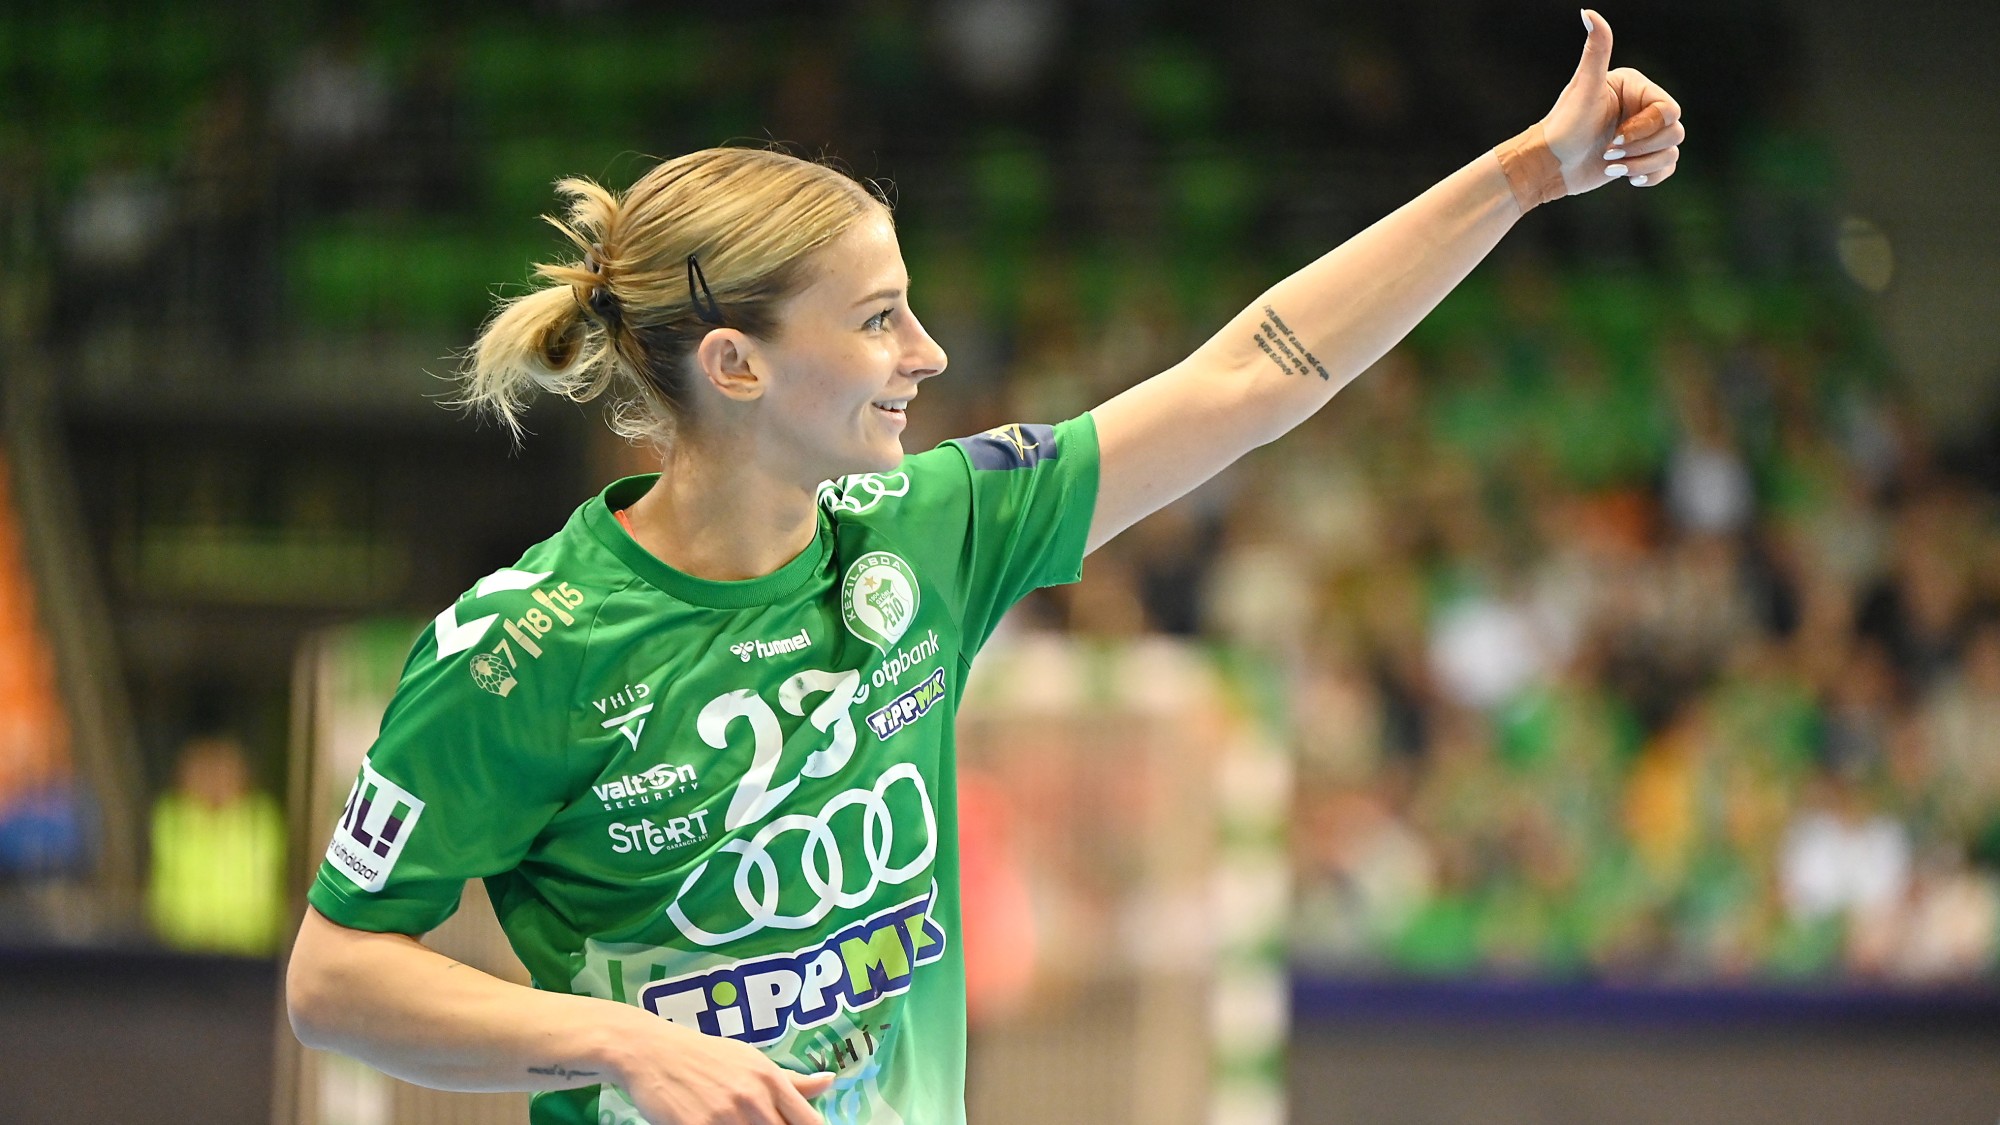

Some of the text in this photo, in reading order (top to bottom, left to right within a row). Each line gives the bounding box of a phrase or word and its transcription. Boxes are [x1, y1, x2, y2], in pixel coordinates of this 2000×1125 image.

[755, 628, 812, 659] hummel
[871, 629, 940, 688] otpbank
[696, 668, 861, 833] 23
[604, 783, 698, 811] SECURITY
